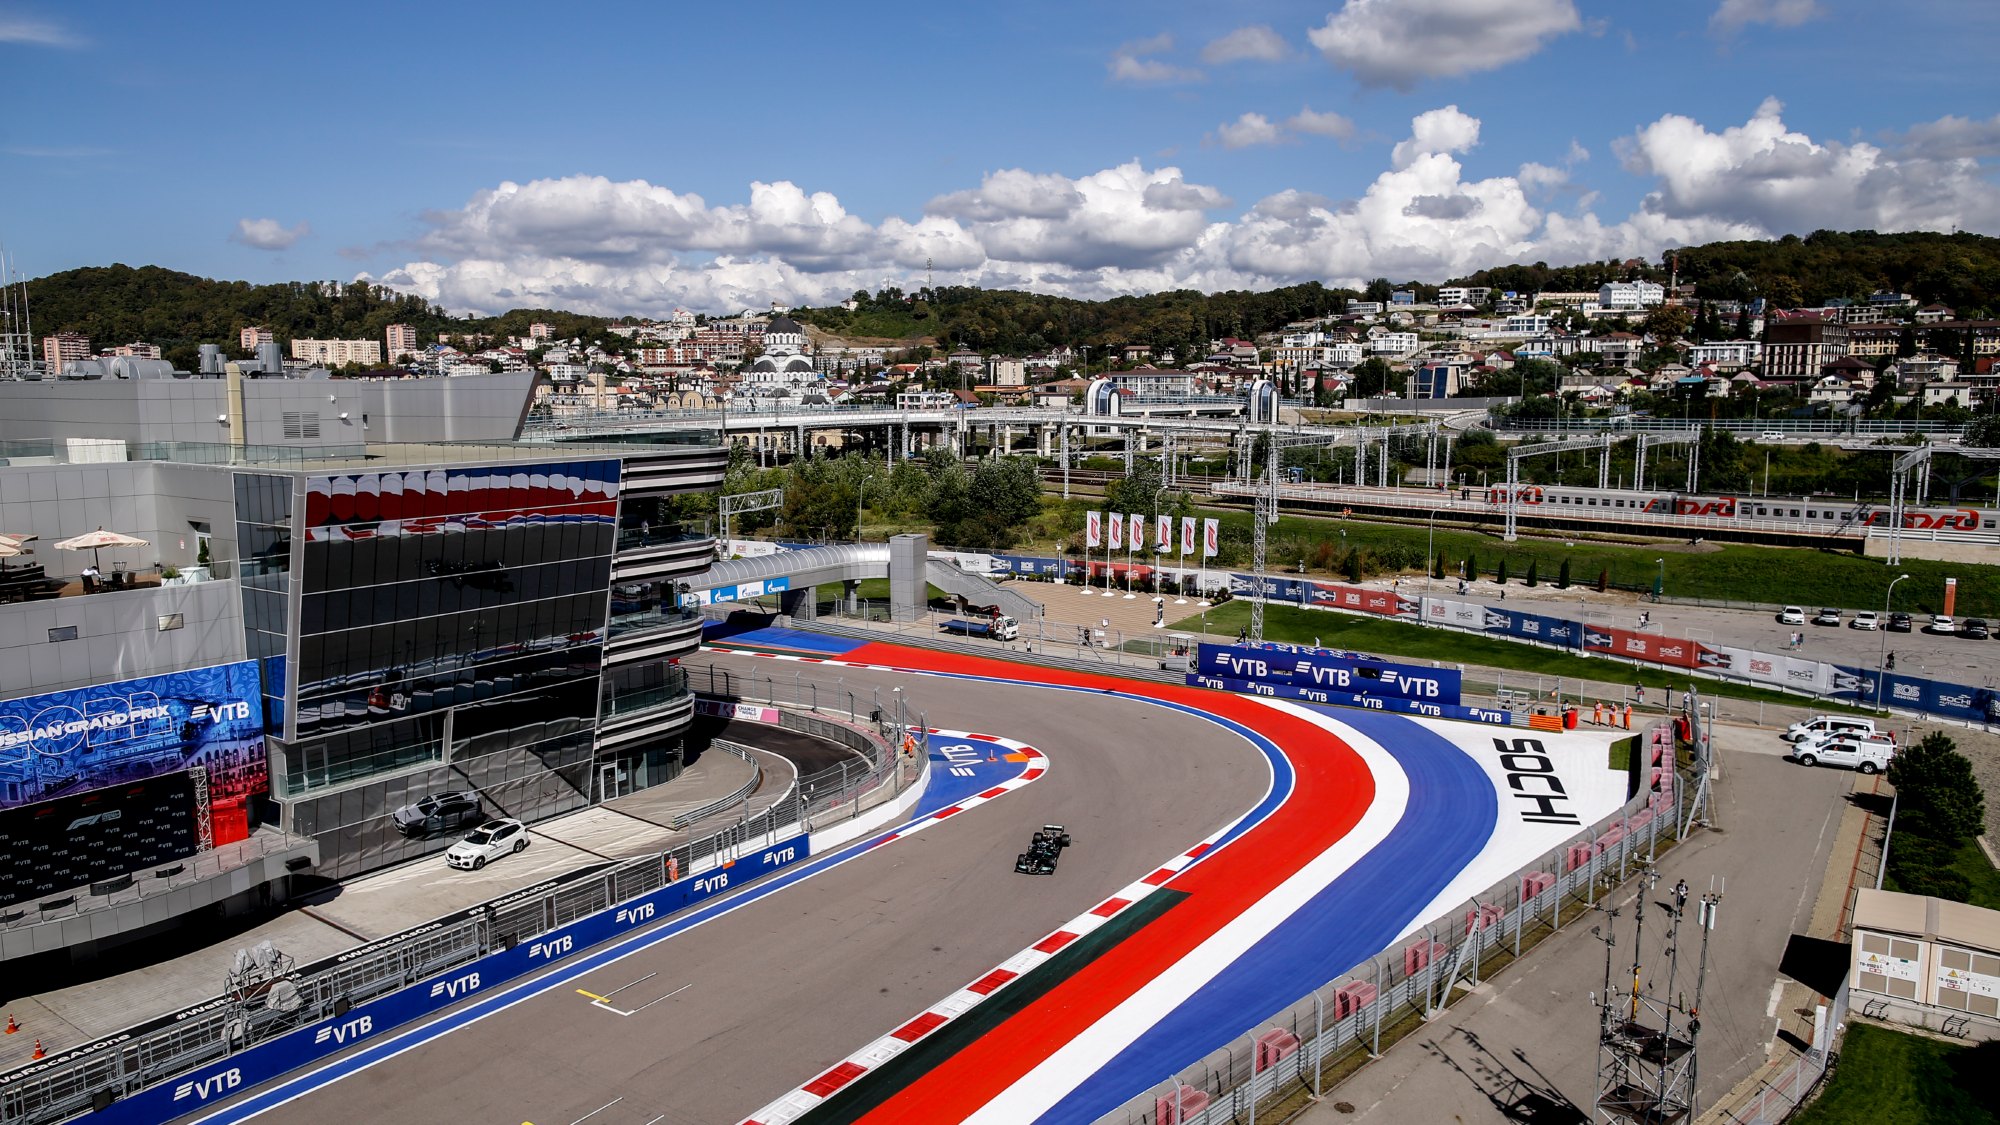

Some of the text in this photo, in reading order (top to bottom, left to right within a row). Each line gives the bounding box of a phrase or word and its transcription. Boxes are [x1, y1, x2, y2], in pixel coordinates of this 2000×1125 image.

[1231, 658, 1268, 677] VTB
[1312, 667, 1350, 686] VTB
[1788, 670, 1813, 678] SOCHI
[1205, 678, 1224, 690] VTB
[1255, 684, 1274, 696] VTB
[1398, 675, 1439, 697] VTB
[1307, 691, 1328, 702] VTB
[1362, 697, 1383, 709] VTB
[1939, 695, 1971, 706] SOCHI
[65, 714, 128, 734] GRAND
[130, 704, 170, 722] PRIX
[210, 702, 250, 724] VTB
[1418, 704, 1441, 717] VTB
[1479, 711, 1502, 723] VTB
[940, 744, 984, 768] VTB
[1492, 737, 1582, 826] SOCHI
[773, 847, 795, 866] VTB
[704, 873, 729, 893] VTB
[468, 881, 558, 916] #WRaceAsOne
[628, 902, 655, 924] VTB
[338, 923, 442, 962] #WeRaceAsOne
[542, 935, 573, 959] VTB
[446, 972, 481, 998] VTB
[333, 1015, 373, 1044] VTB
[194, 1067, 242, 1100] VTB
